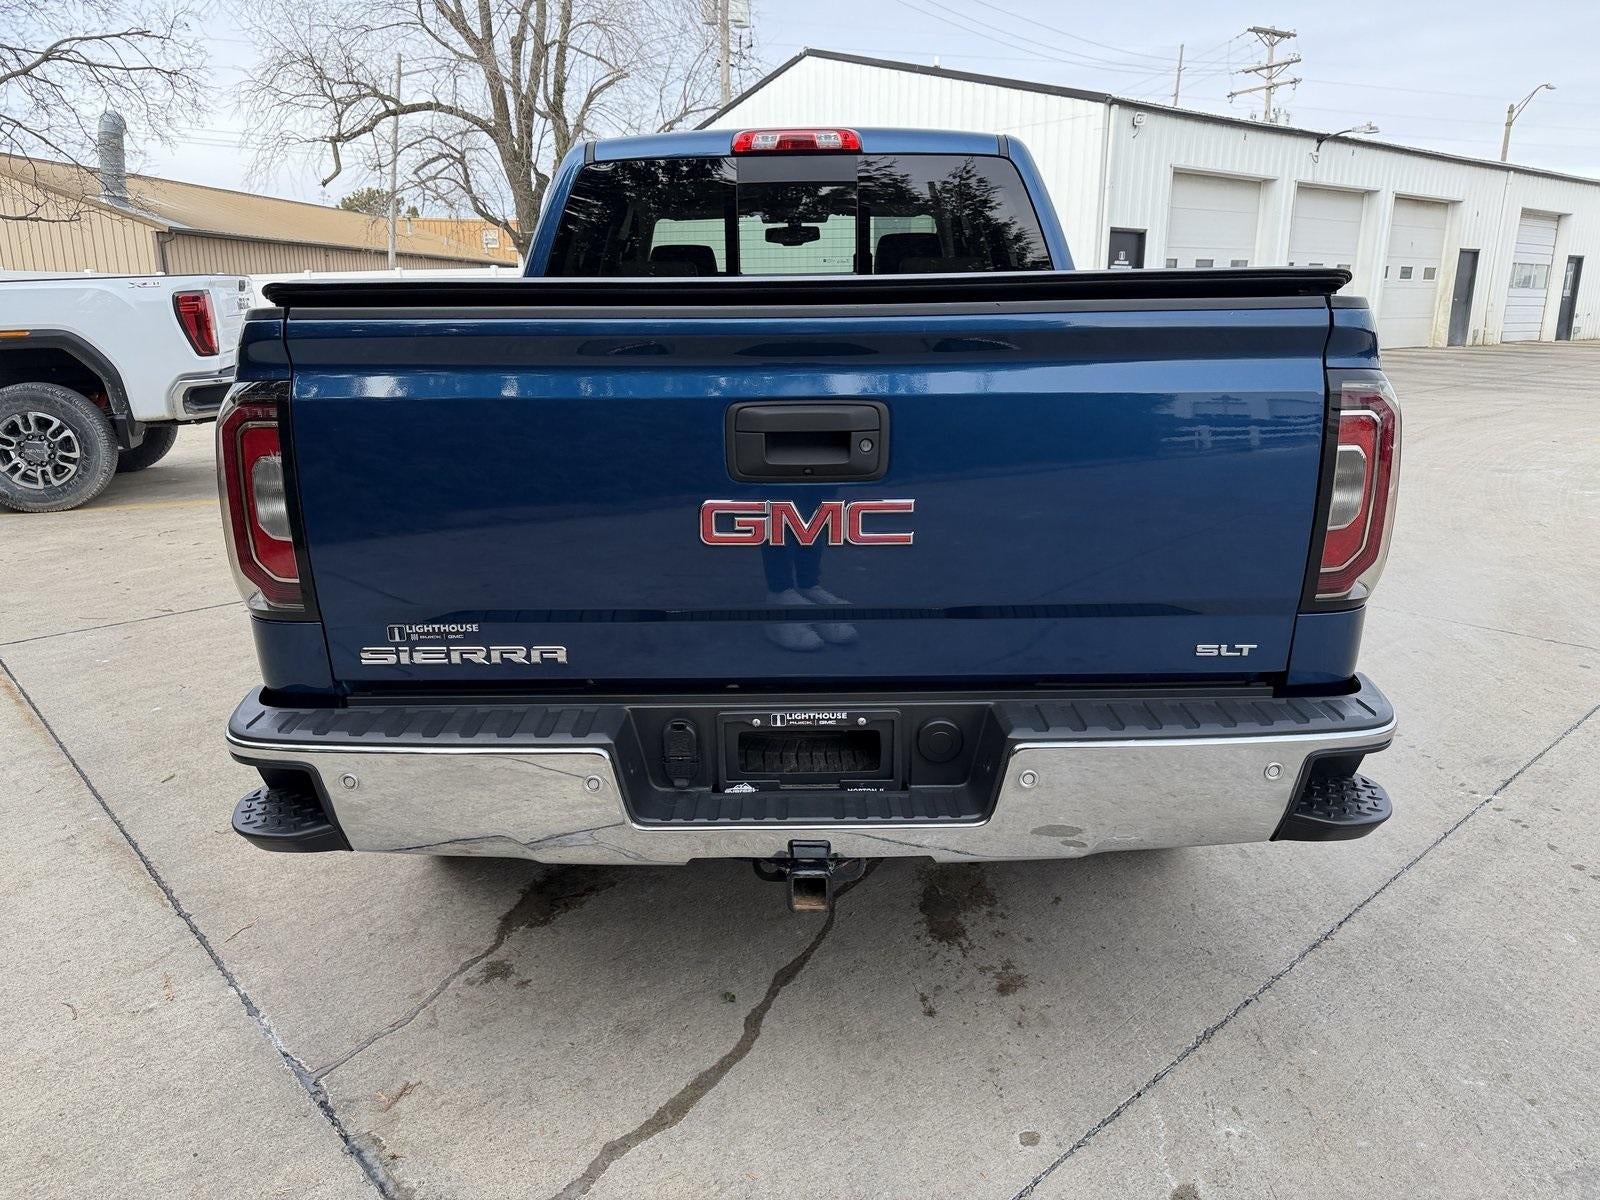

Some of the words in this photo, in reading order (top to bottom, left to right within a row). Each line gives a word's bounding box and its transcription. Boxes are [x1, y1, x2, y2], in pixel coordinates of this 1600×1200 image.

[700, 499, 915, 546] GMC
[406, 623, 480, 633] LIGHTHOUSE
[360, 646, 568, 665] SIERRA
[1195, 644, 1258, 657] SLT
[786, 712, 848, 720] LIGHTHOUSE
